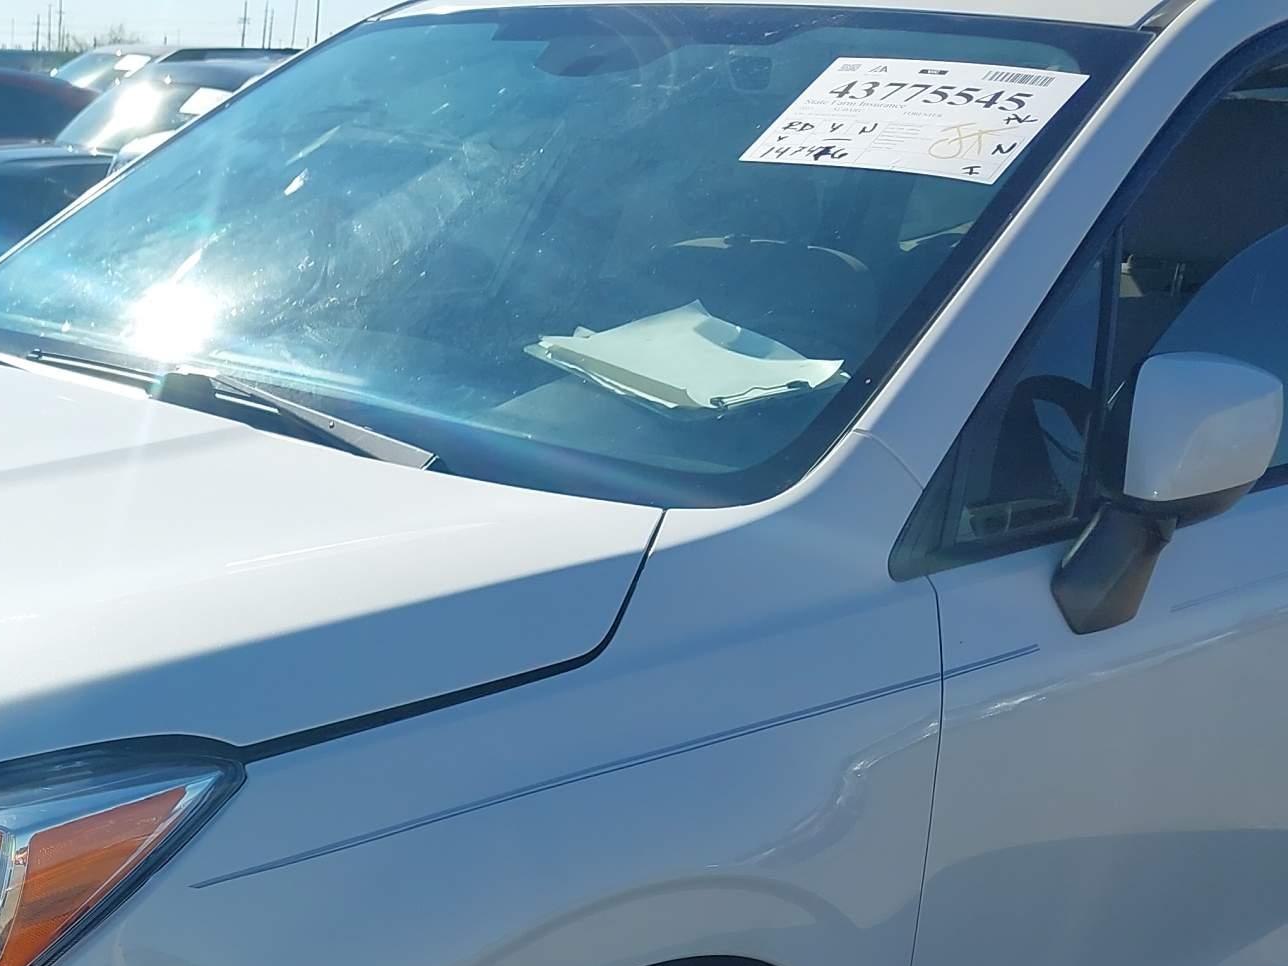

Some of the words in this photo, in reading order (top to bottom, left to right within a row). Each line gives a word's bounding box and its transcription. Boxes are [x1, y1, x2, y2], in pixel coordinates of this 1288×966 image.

[828, 80, 1034, 112] 43775545
[831, 99, 856, 107] Farm
[858, 100, 907, 109] Insurance
